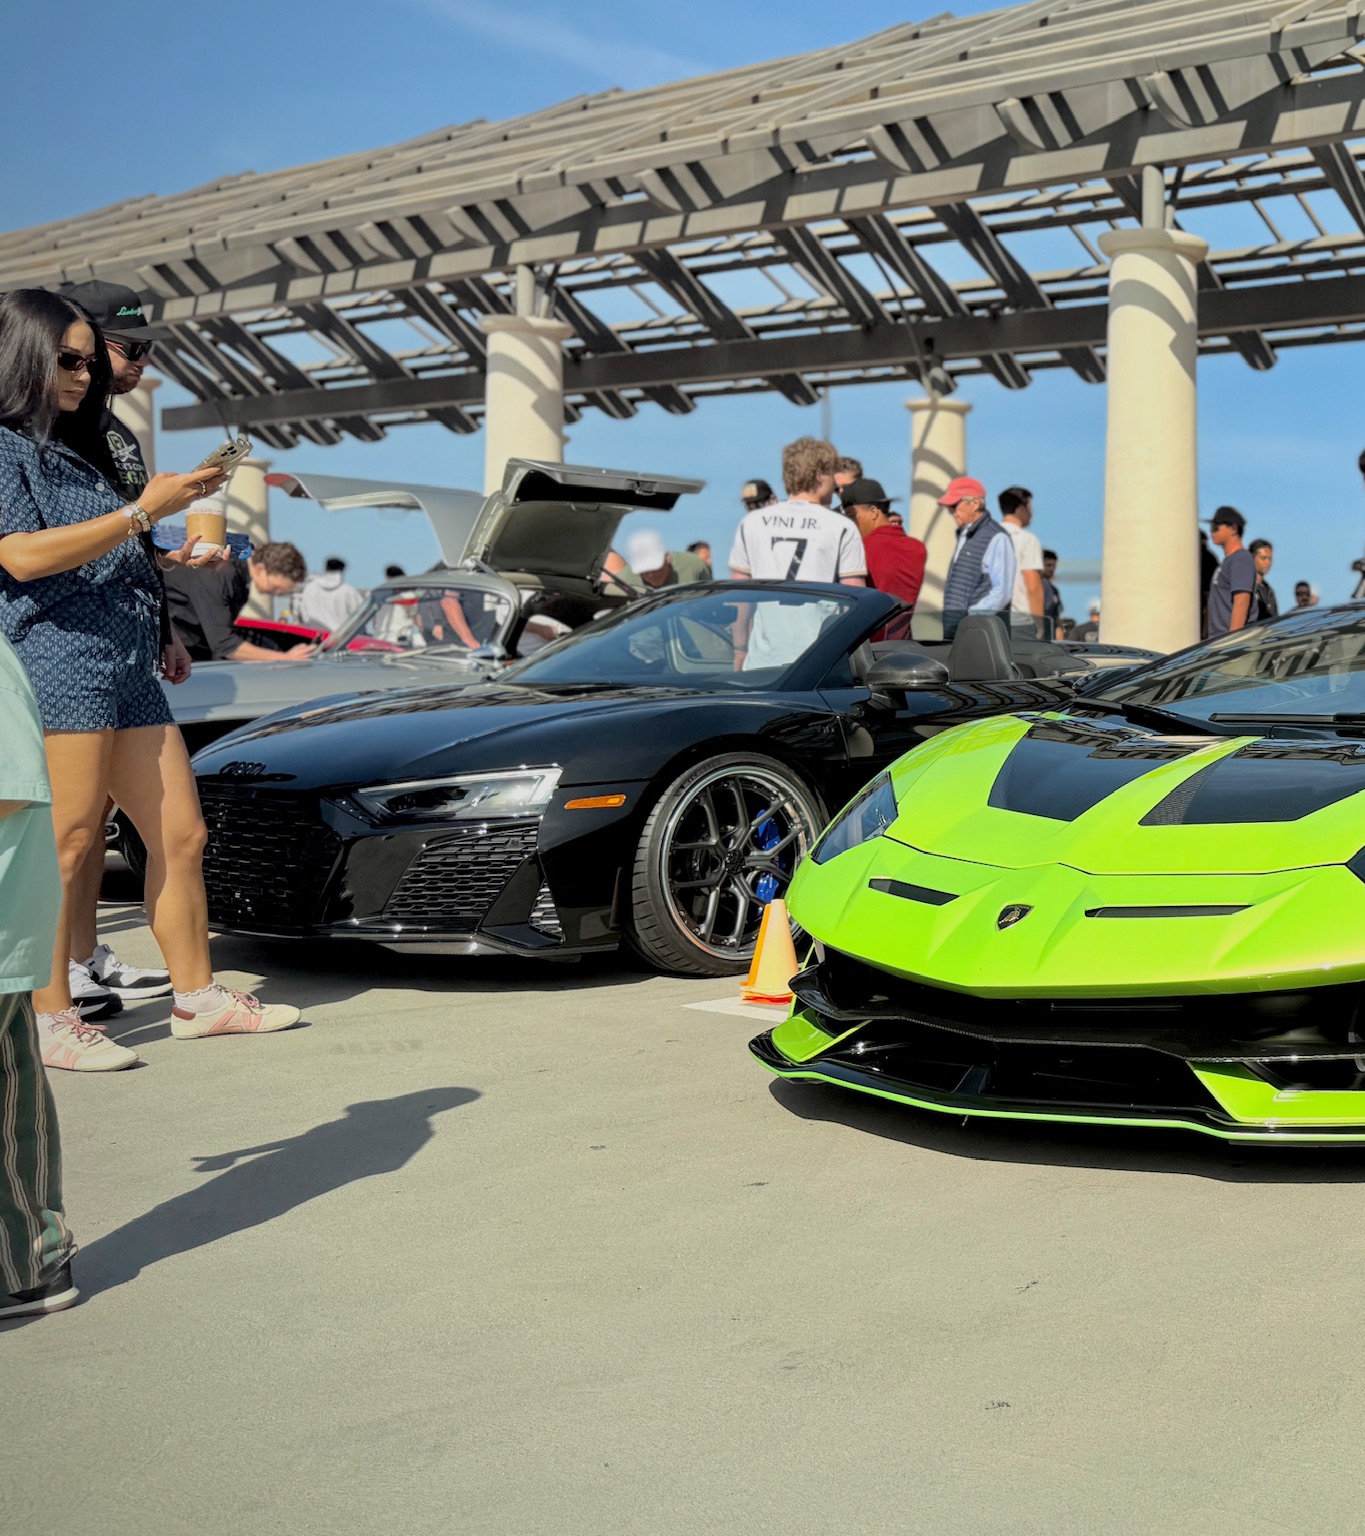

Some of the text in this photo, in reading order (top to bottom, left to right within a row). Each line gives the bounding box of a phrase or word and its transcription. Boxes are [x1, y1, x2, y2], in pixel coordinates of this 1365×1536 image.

[762, 516, 821, 530] VINI JR.
[771, 536, 808, 580] 7
